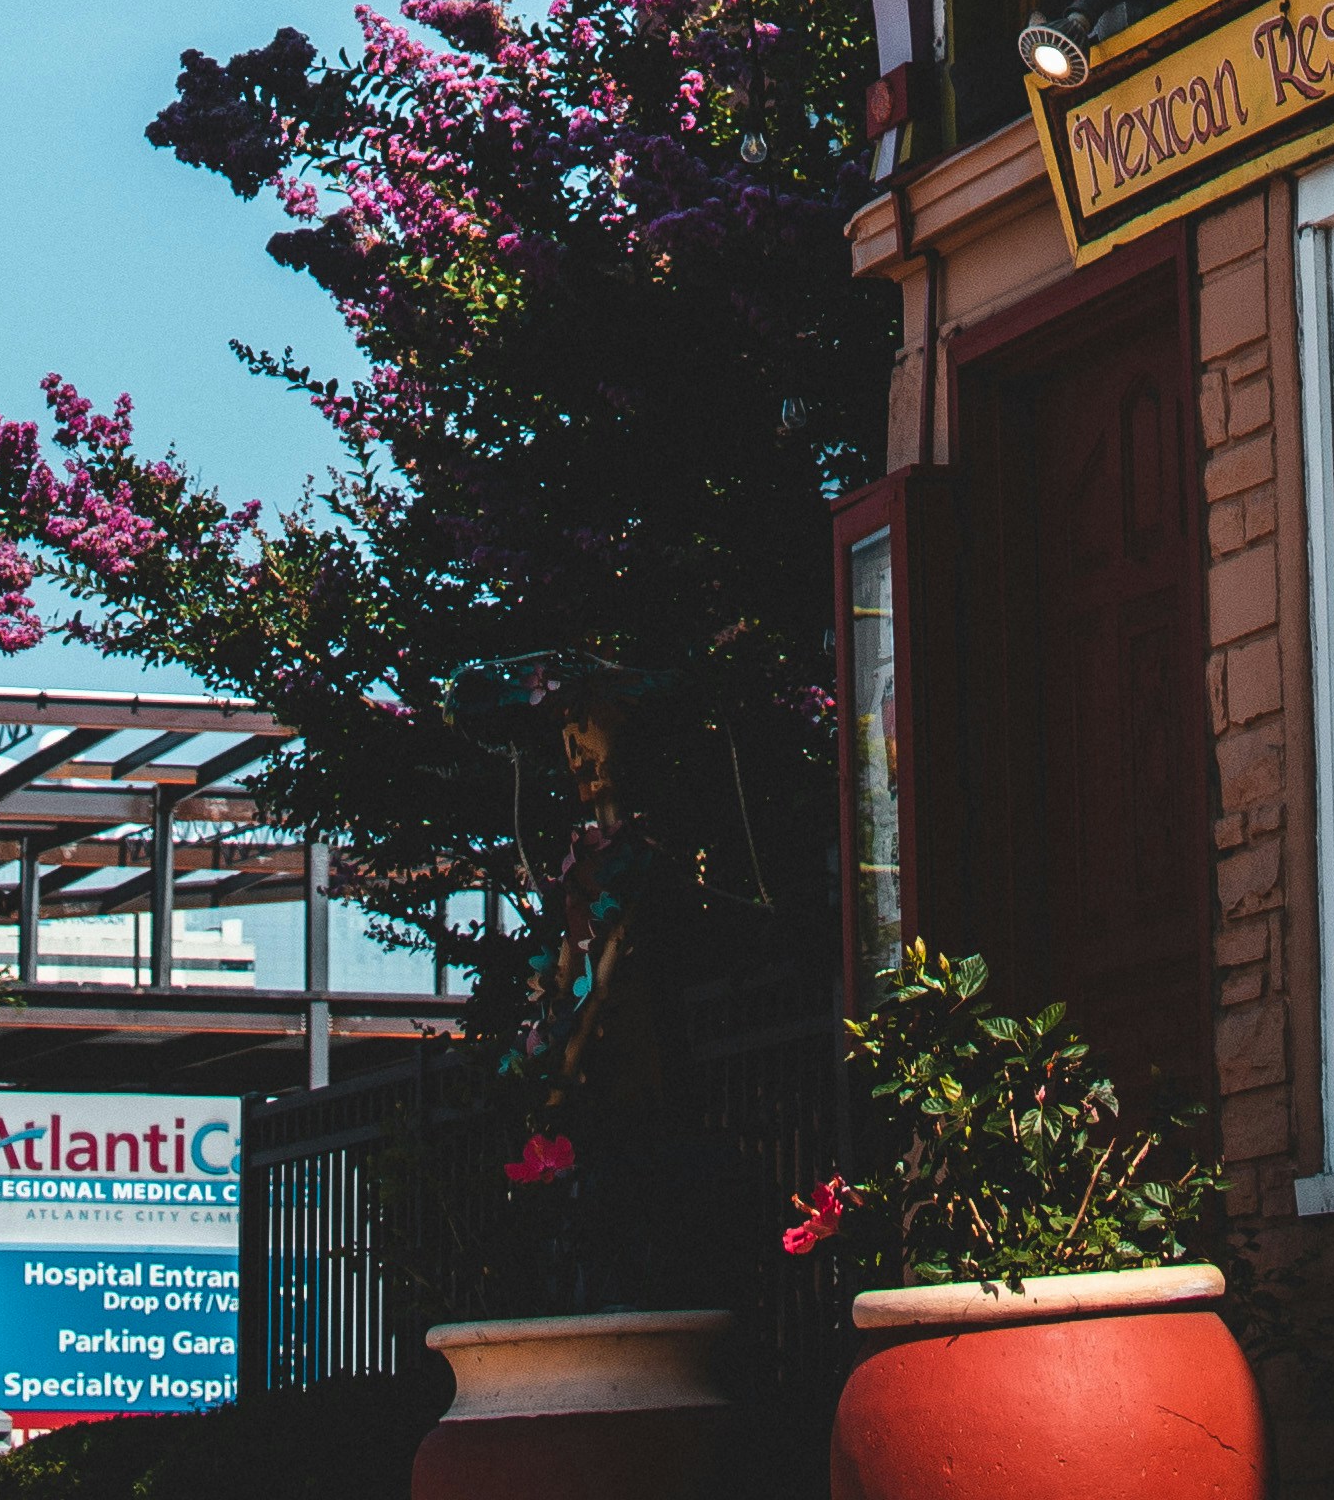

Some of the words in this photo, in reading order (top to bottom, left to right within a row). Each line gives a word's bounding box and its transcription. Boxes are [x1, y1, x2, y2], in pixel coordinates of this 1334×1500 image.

[1073, 56, 1249, 200] Mexican
[112, 1182, 217, 1202] MEDICAL
[222, 1184, 238, 1202] C
[25, 1208, 124, 1222] ATLANTIC
[135, 1210, 180, 1223] CITY
[23, 1261, 142, 1291] Hospital
[149, 1263, 239, 1288] Entran
[103, 1291, 159, 1315] Drop
[58, 1328, 166, 1360] Parking
[172, 1330, 236, 1355] Gara
[3, 1371, 144, 1403] Specialty
